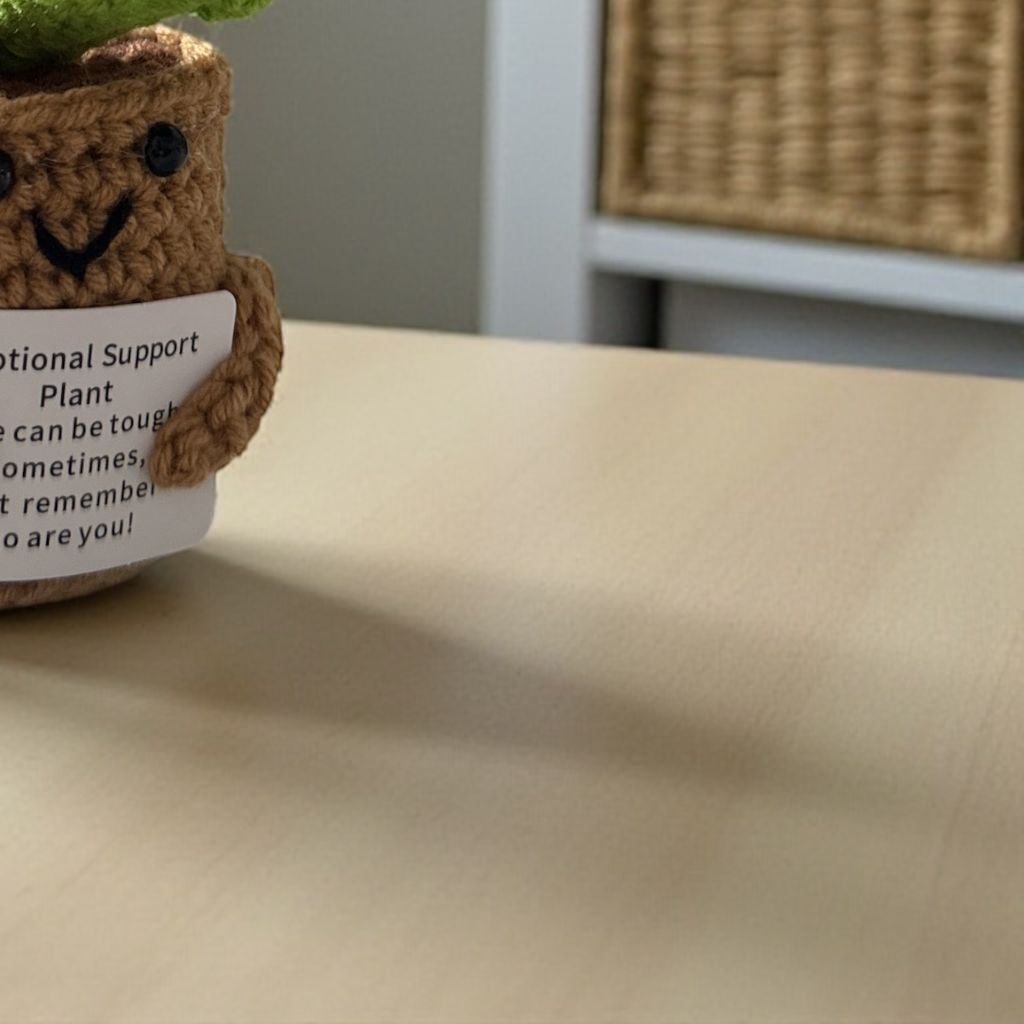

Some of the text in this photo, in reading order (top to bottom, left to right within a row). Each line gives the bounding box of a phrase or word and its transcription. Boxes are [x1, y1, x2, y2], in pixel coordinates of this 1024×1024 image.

[102, 331, 200, 370] Support
[39, 380, 114, 409] Plant
[13, 425, 63, 443] can
[71, 417, 103, 440] be
[27, 528, 72, 549] are
[79, 512, 134, 549] you!
